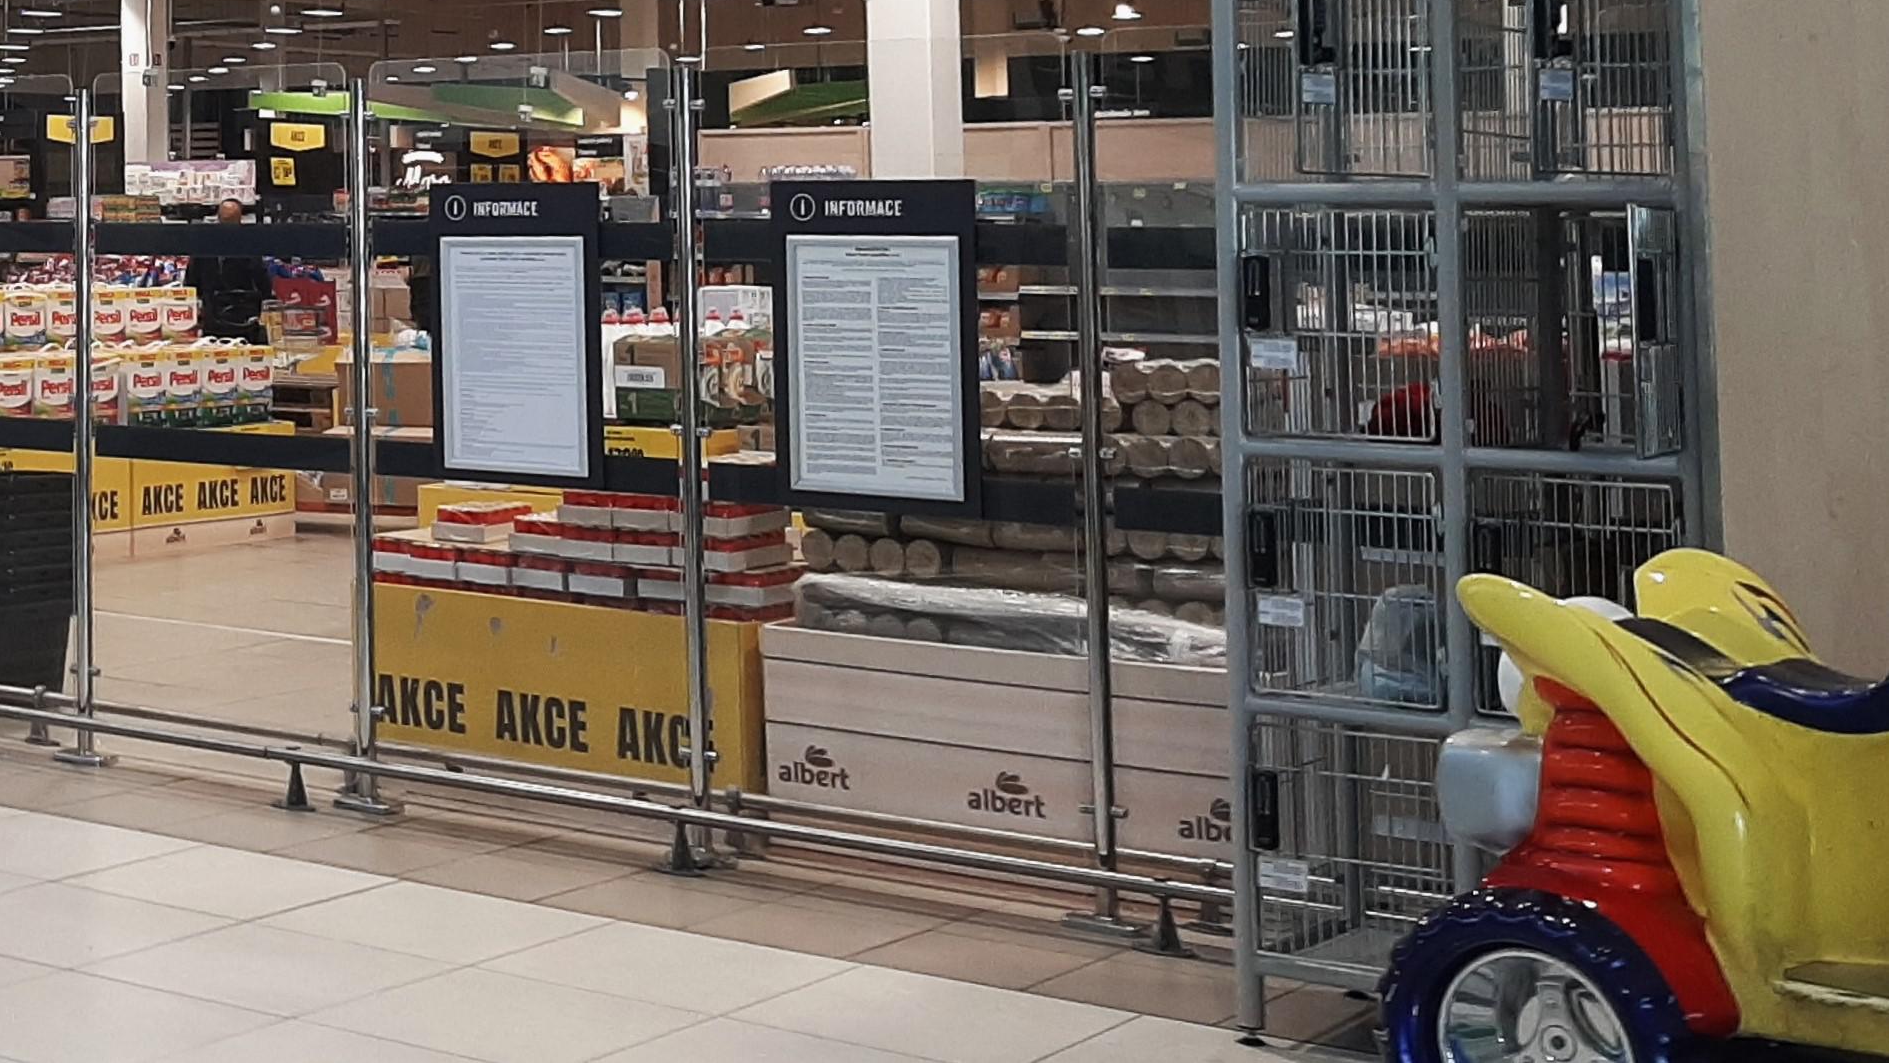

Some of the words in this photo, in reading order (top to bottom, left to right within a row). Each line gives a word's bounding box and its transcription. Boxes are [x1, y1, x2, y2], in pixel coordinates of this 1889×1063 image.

[473, 201, 540, 217] INFORMACE
[824, 199, 903, 217] INFORMACE
[11, 311, 41, 327] Persil
[130, 308, 158, 323] Persil
[167, 306, 194, 325] Persil
[133, 372, 162, 387] Persil
[170, 369, 198, 386] Persil
[208, 367, 235, 383] Persil
[243, 365, 271, 382] Persil
[41, 378, 74, 398] Persil
[142, 483, 184, 516] AKCE
[197, 478, 239, 510] AKCE
[250, 474, 286, 505] AKCE
[378, 674, 466, 734] AKCE
[496, 689, 588, 753] AKCE
[778, 761, 850, 790] albert
[967, 789, 1046, 819] albert
